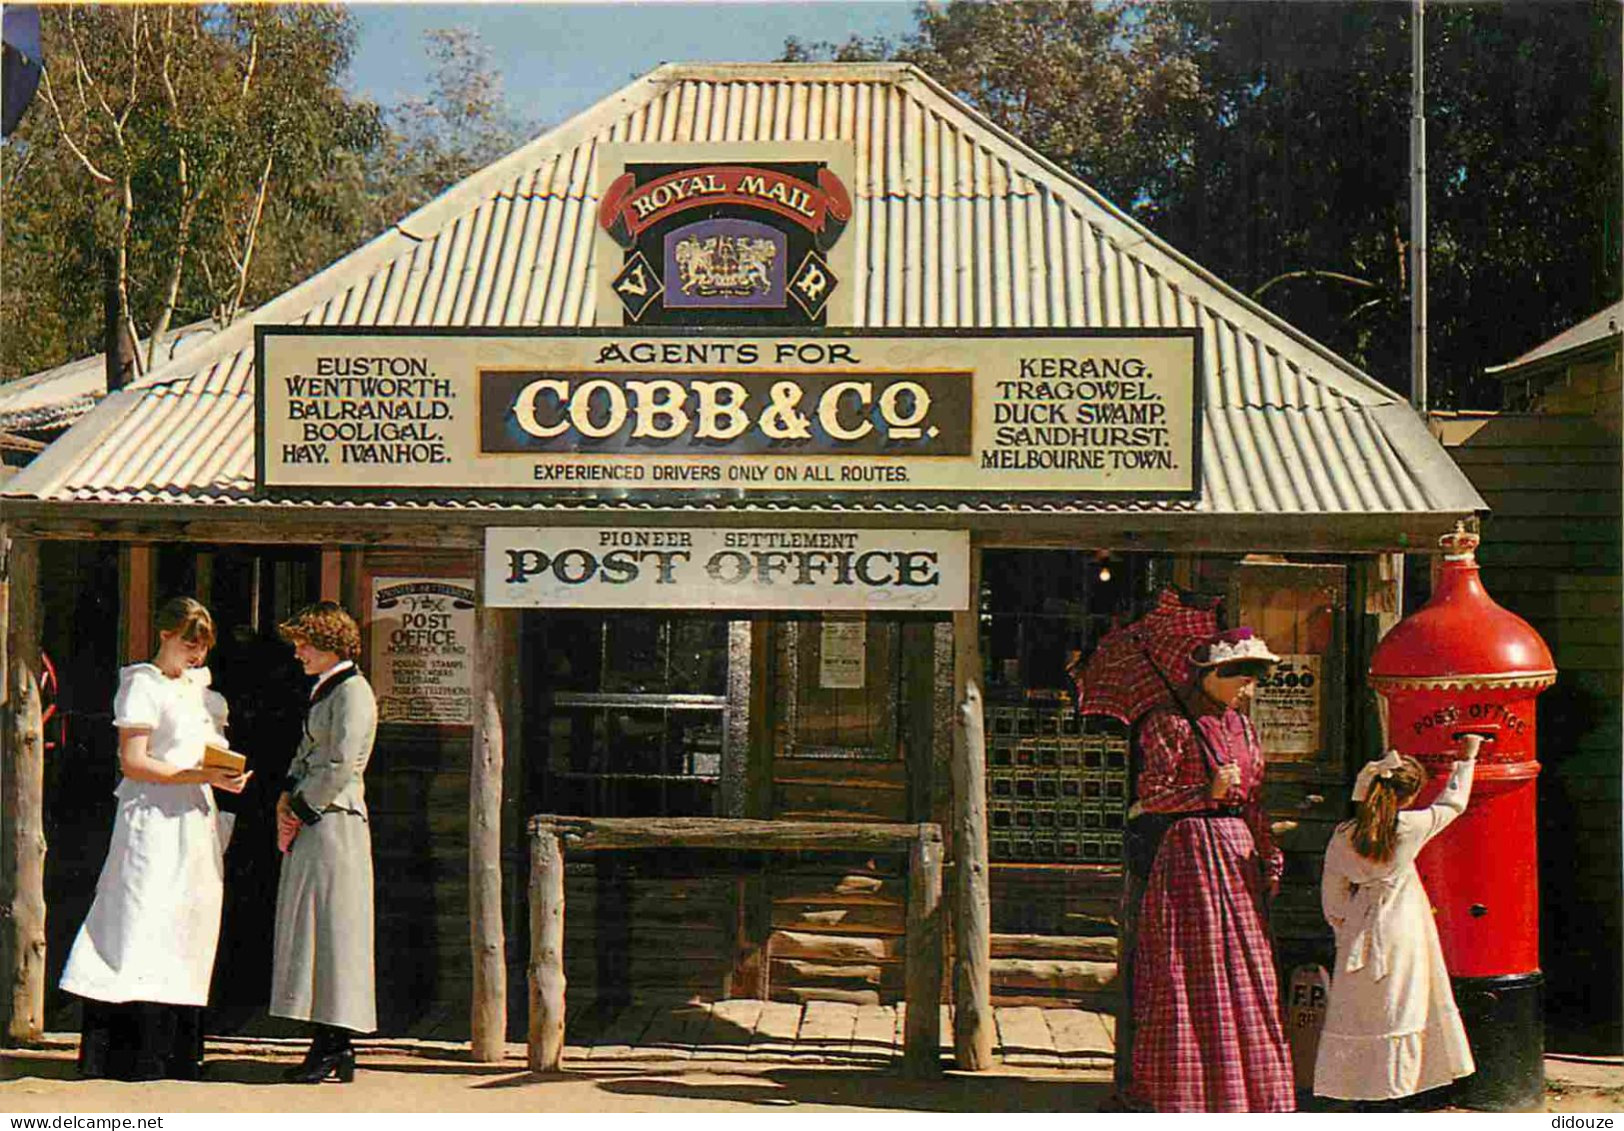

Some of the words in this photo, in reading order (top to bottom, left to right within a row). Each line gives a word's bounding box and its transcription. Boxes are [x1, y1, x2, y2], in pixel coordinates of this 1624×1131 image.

[631, 175, 726, 219] ROYAL
[737, 175, 816, 218] MAIL
[618, 264, 648, 297] V
[797, 263, 827, 301] R
[595, 343, 759, 364] AGENTS
[774, 343, 860, 365] FOR
[316, 357, 437, 379] EUSTON.
[1019, 357, 1153, 380] KERANG.
[285, 376, 457, 399] WENTWORTH.
[996, 381, 1162, 401] TRAGOWEL.
[288, 401, 454, 421] BALRANALD.
[993, 404, 1066, 425] DUCK
[1076, 404, 1167, 425] SWAMP.
[302, 423, 444, 442] BOOLIGAL.
[996, 428, 1170, 447] SANDHURST.
[281, 444, 330, 464] HAY.
[341, 443, 453, 464] IVANHOE.
[980, 450, 1105, 469] MELBOURNE
[1107, 450, 1179, 469] TOWN.
[534, 465, 644, 481] EXPERIENCED
[653, 466, 721, 482] DRIVERS
[728, 466, 767, 482] ONLY
[774, 466, 798, 482] ON
[803, 466, 835, 482] ALL
[841, 466, 911, 483] ROUTES.
[599, 531, 693, 548] PIONEER
[724, 532, 859, 550] SETTLEMENT
[505, 549, 692, 585] POST
[704, 549, 940, 587] OFFICE
[402, 614, 452, 629] POST
[391, 629, 456, 646] OFFICE
[1413, 706, 1459, 735] POST
[1468, 703, 1526, 735] OFFICE
